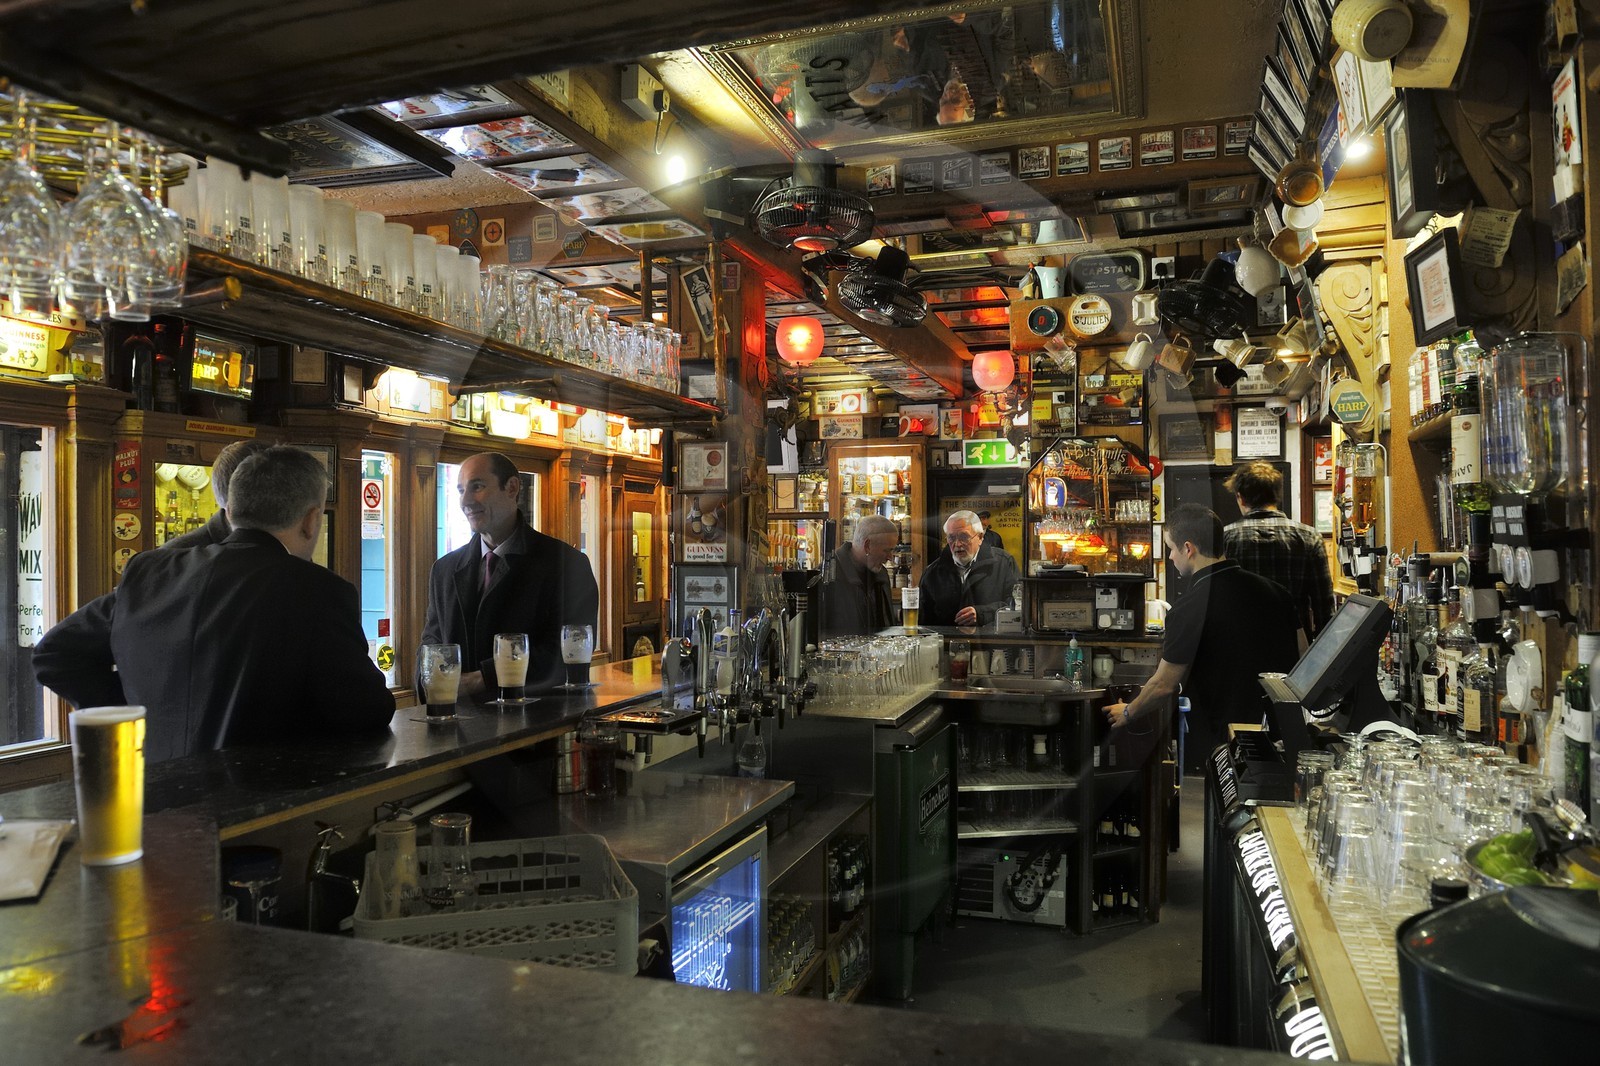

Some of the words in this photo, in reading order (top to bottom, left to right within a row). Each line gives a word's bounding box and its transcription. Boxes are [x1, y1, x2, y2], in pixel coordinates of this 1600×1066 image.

[1082, 265, 1132, 276] CAPSTAN
[1337, 401, 1366, 412] HARP
[115, 449, 139, 460] WALNUT
[120, 458, 136, 468] PLUG
[945, 501, 959, 509] THE
[962, 500, 1000, 509] SENSIBLE
[1004, 500, 1021, 508] MAN
